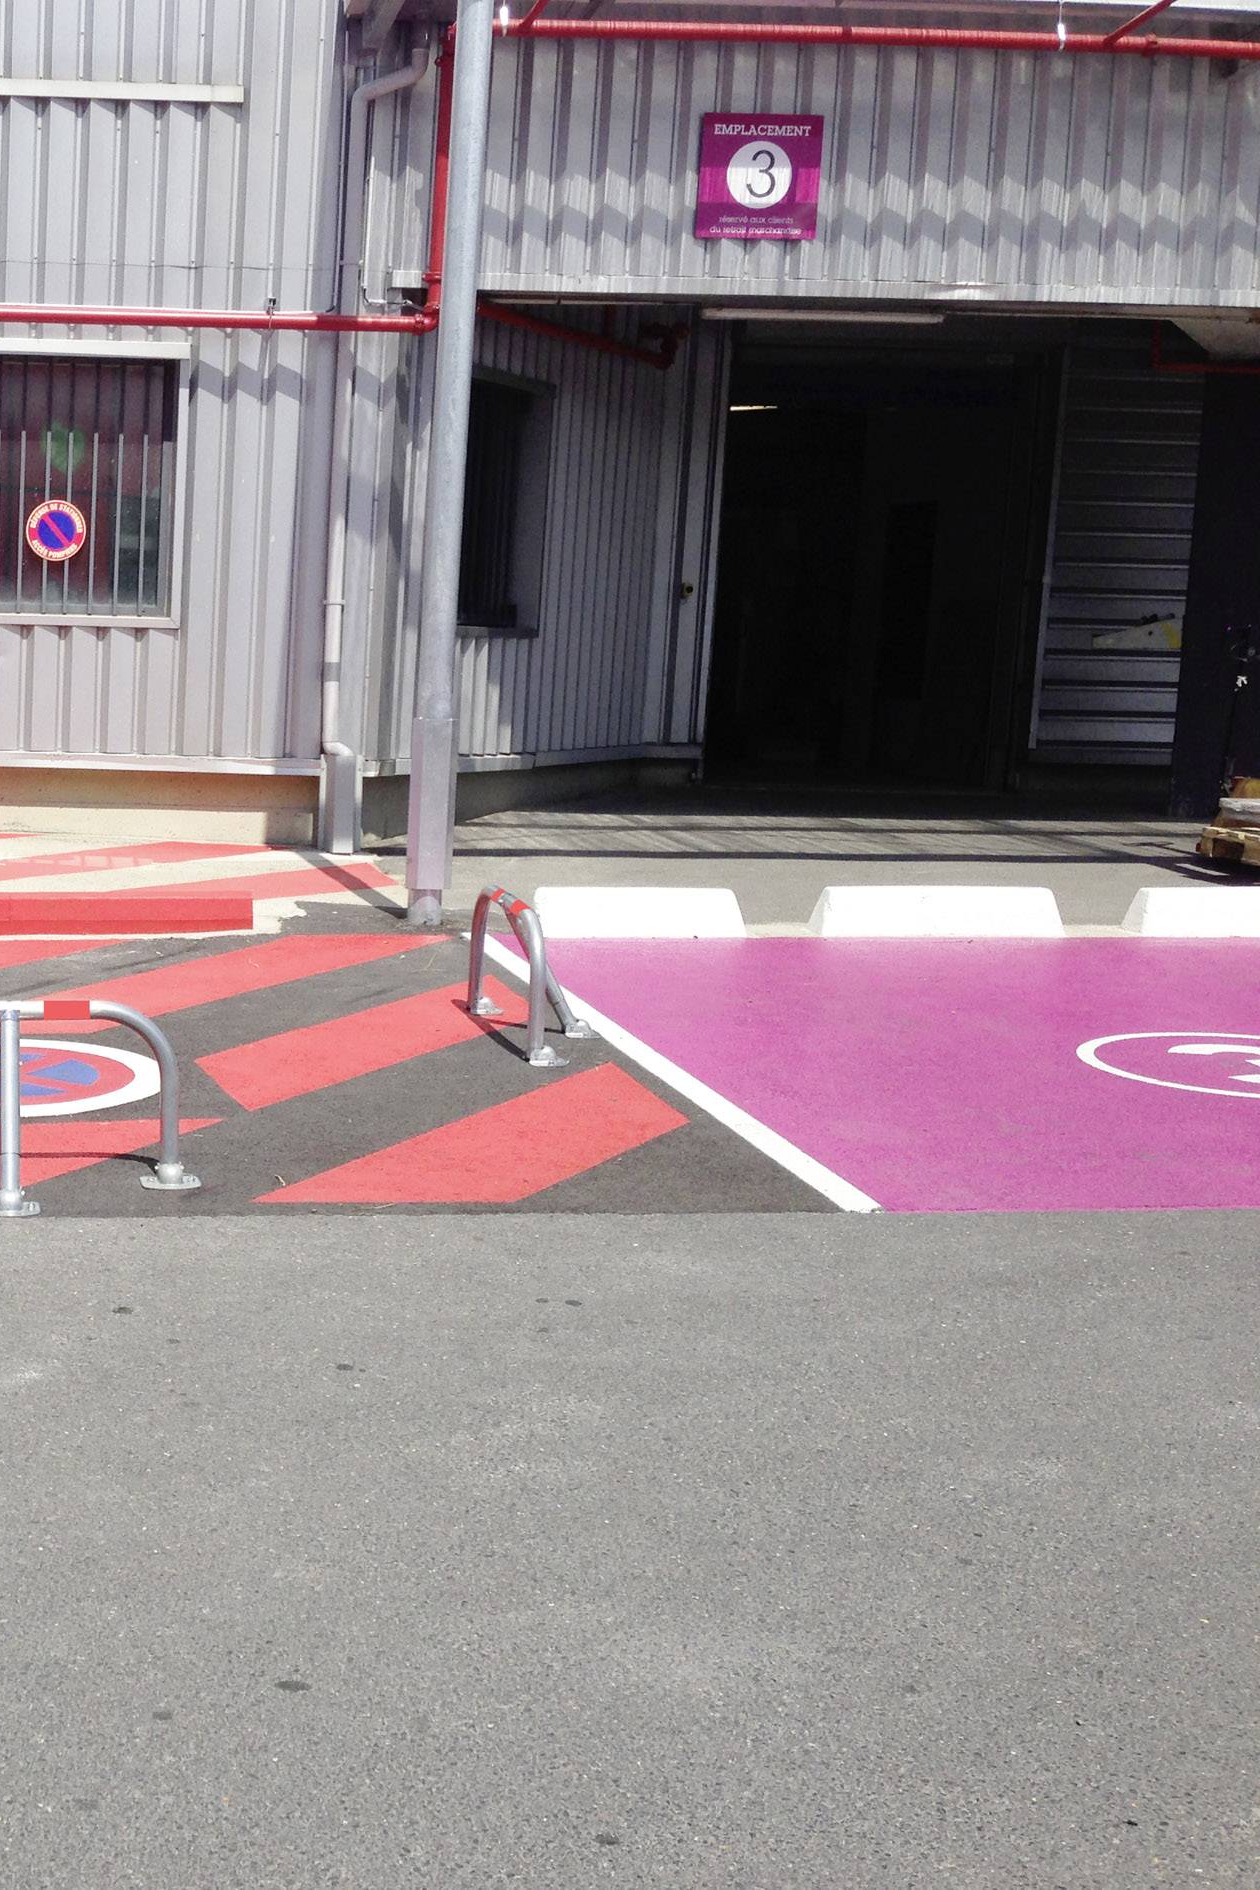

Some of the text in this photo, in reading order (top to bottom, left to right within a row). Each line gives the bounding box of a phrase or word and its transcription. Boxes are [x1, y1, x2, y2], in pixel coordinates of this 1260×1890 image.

[714, 124, 812, 137] EMPLACEMENT
[746, 149, 776, 198] 3
[767, 216, 794, 225] clients
[709, 225, 802, 235] du retrait marchandise
